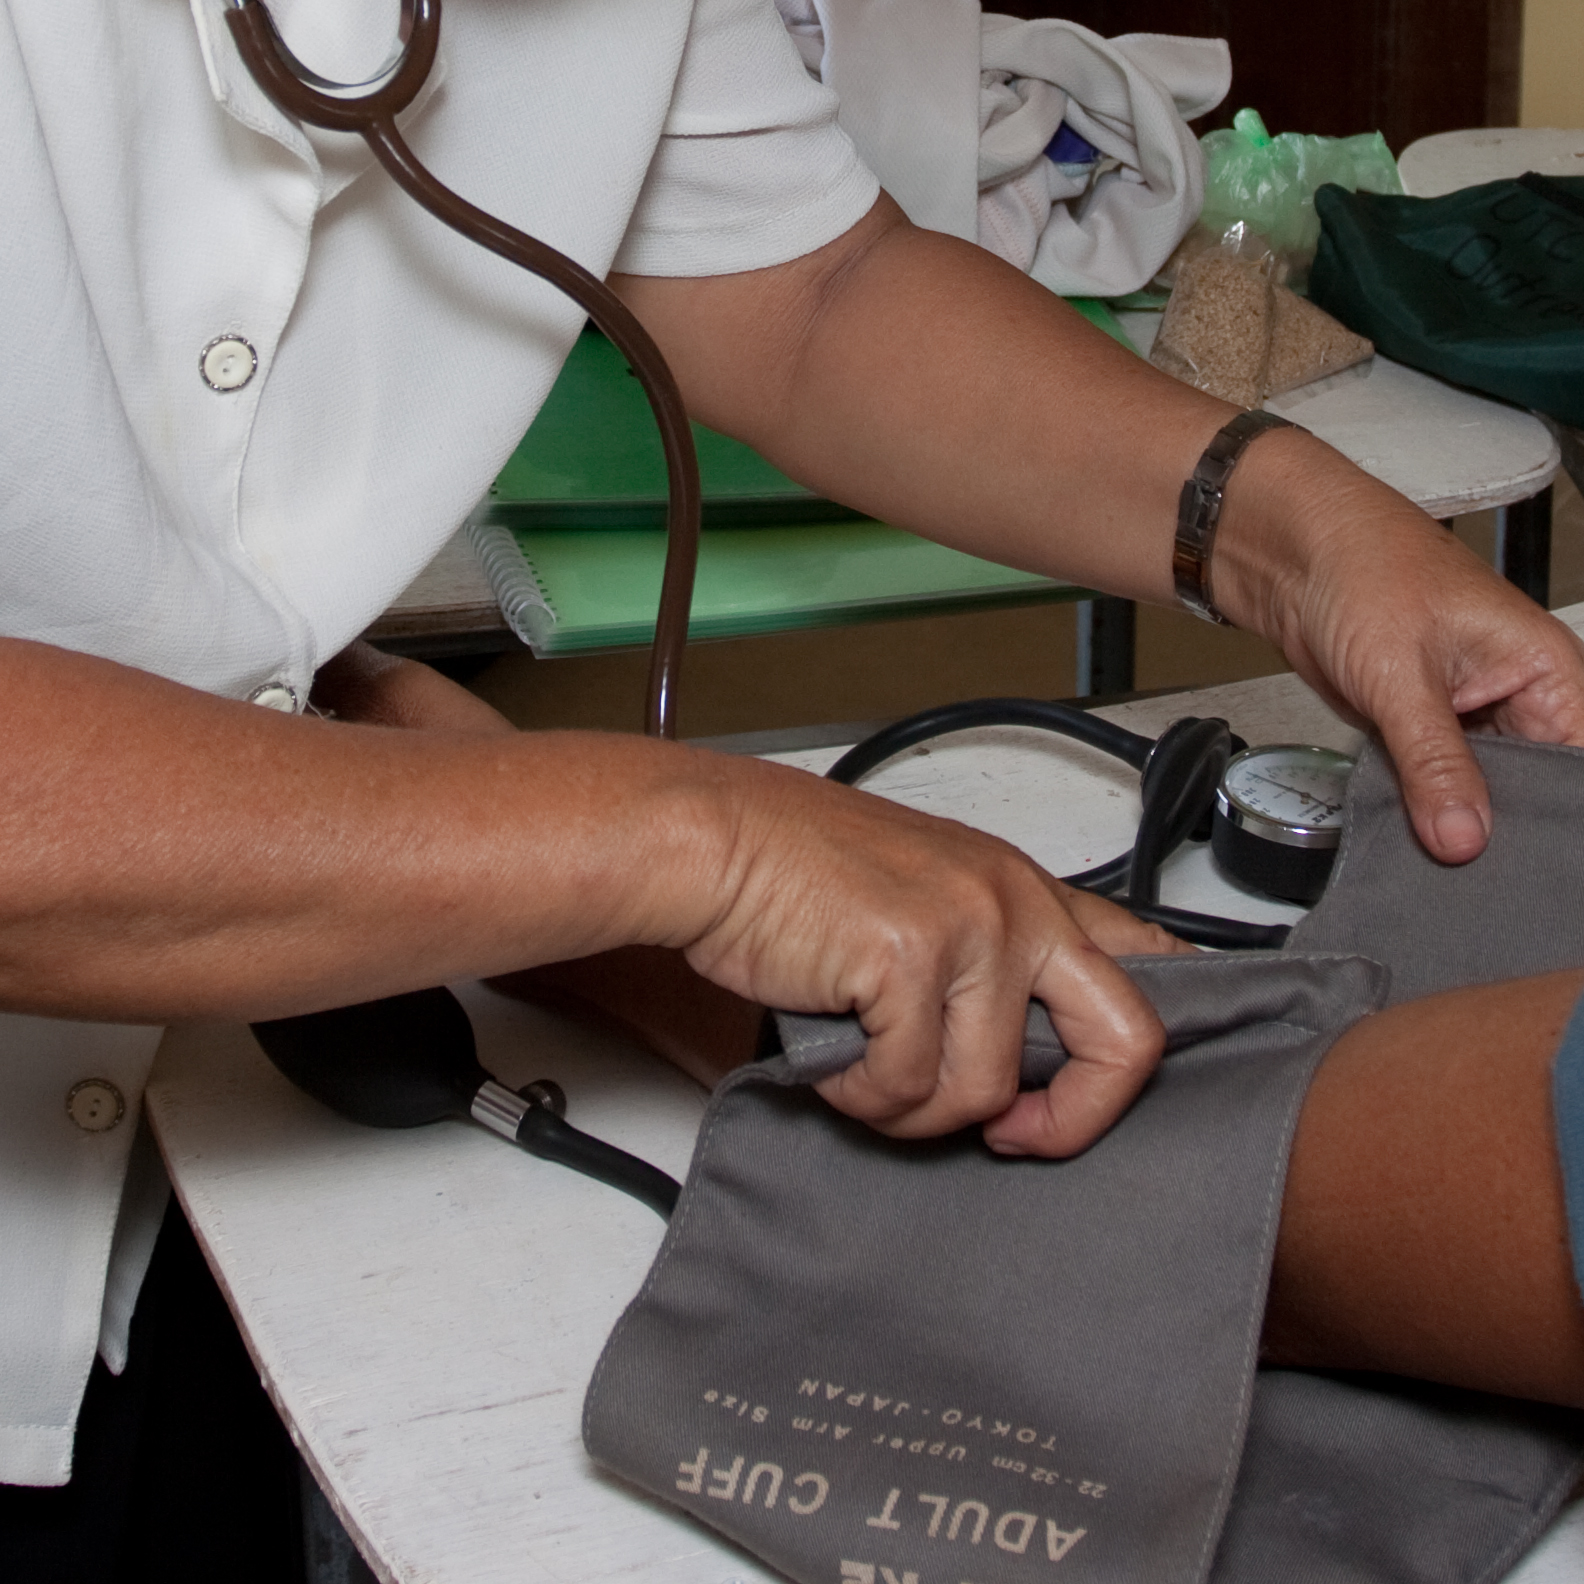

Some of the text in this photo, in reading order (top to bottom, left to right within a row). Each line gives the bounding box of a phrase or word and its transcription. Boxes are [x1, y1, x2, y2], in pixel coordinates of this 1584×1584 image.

[703, 1389, 769, 1424] Size
[798, 1378, 910, 1416] JAPAN
[792, 1417, 852, 1440] Arm
[941, 1409, 1057, 1451] TOKYO
[873, 1434, 967, 1461] Upper
[676, 1447, 1088, 1562] ADULT CUFF
